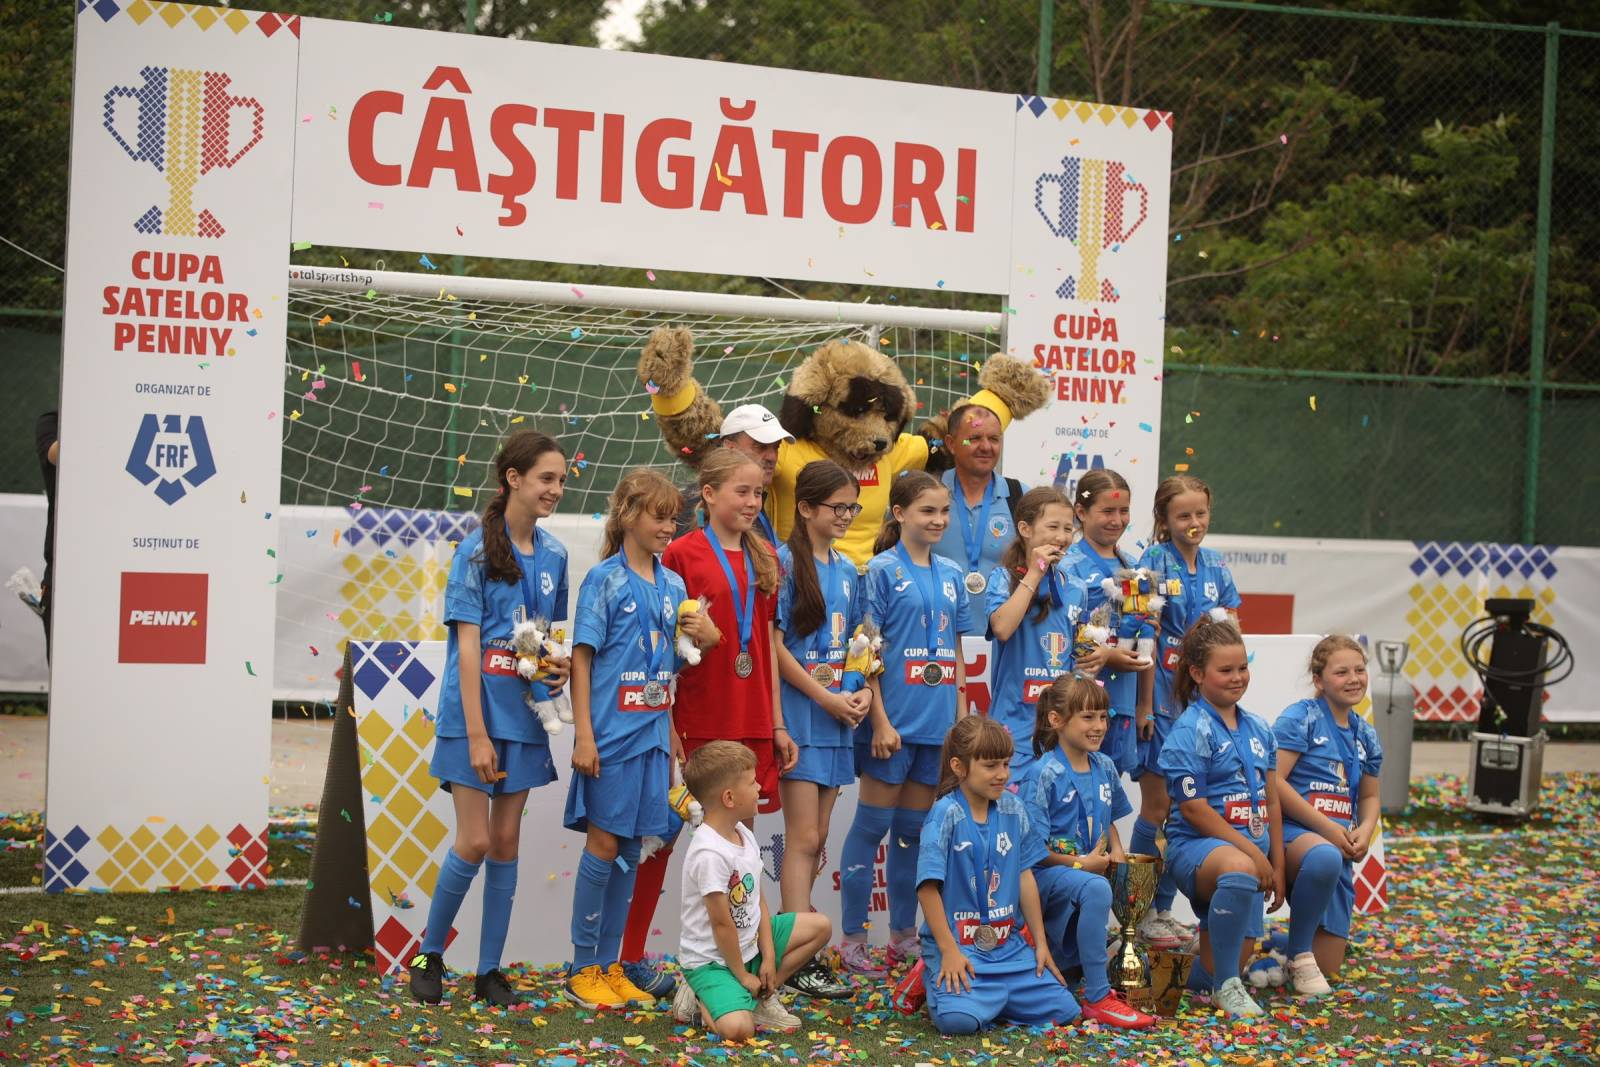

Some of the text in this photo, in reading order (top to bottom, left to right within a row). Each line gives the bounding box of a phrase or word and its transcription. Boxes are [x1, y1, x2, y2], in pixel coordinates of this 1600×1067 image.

[131, 250, 224, 284] CUPA
[102, 285, 250, 322] SATELOR
[1053, 313, 1119, 342] CUPA
[1033, 344, 1137, 375] SATELOR
[135, 382, 212, 397] ORGANIZAT DE
[1055, 426, 1110, 438] ORGANAT DE
[155, 444, 189, 468] FRF
[185, 538, 200, 549] DE
[904, 648, 929, 657] CUPA
[1024, 667, 1048, 676] CUPA
[1182, 776, 1197, 798] C
[1310, 781, 1335, 793] CUPA
[954, 911, 980, 921] CUPA
